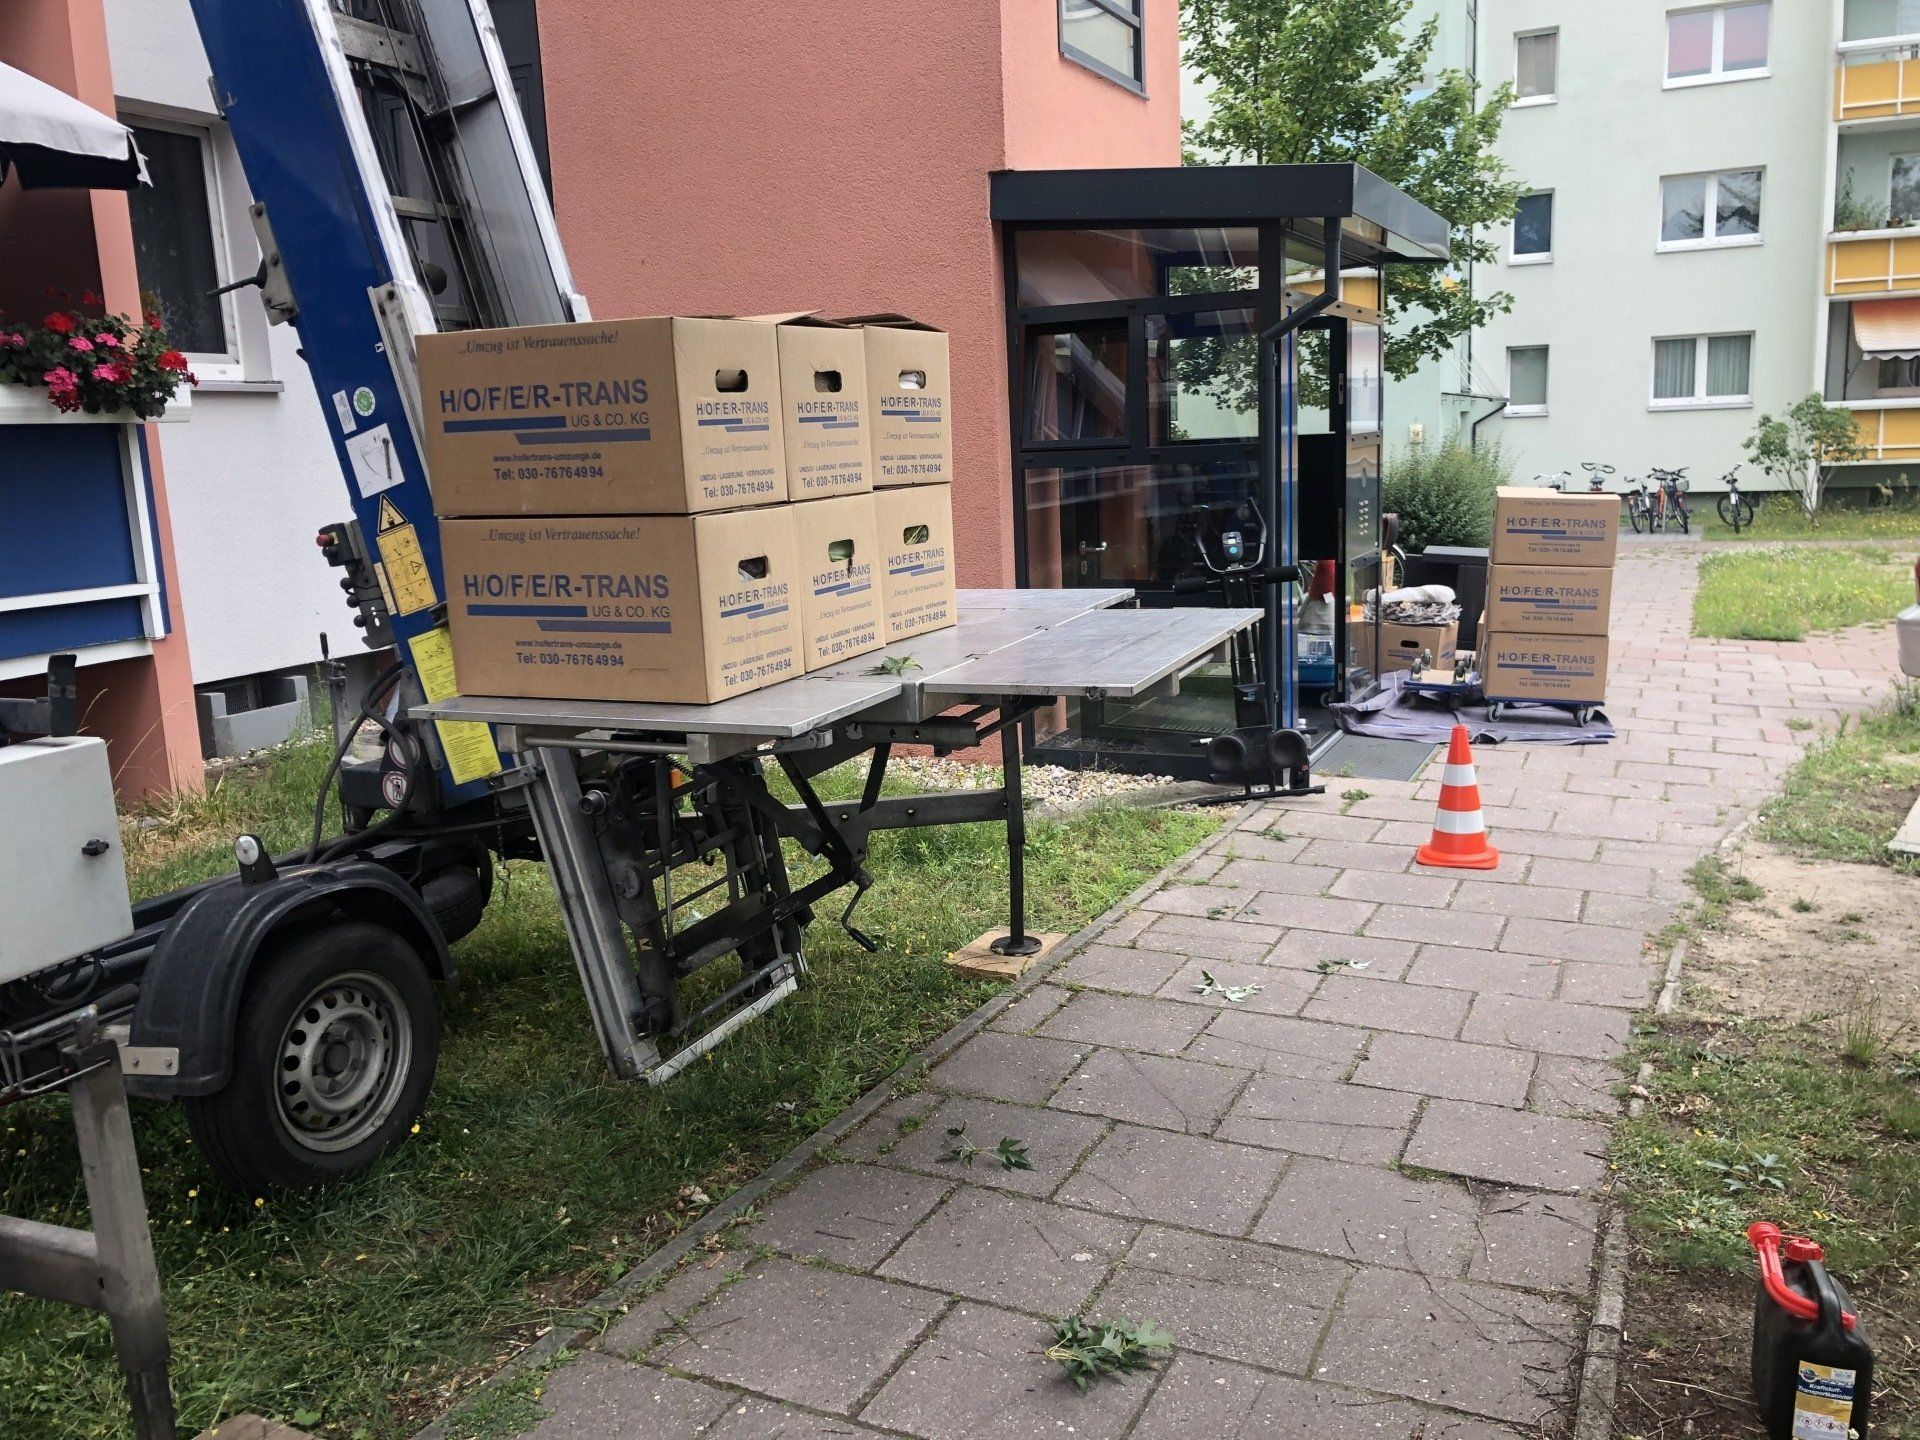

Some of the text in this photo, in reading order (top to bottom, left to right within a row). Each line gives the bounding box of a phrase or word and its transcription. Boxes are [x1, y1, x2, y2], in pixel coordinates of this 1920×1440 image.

[506, 337, 519, 350] ist
[523, 330, 619, 348] Vertrauenssache!
[571, 411, 649, 427] UG & CO. KG
[494, 468, 515, 480] Tel:
[882, 465, 895, 475] Tel:
[802, 477, 815, 488] Tel:
[704, 487, 719, 498] Tel:
[529, 528, 542, 541] ist
[545, 527, 641, 541] Vertrauenssache!
[593, 606, 670, 618] UG & CO. KG
[515, 639, 623, 650] www.hofertrans-umzuege.de
[818, 646, 831, 657] Tel:
[516, 652, 537, 664] Tel:
[724, 674, 739, 687] Tel:
[1798, 1385, 1853, 1400] Transportkanister
